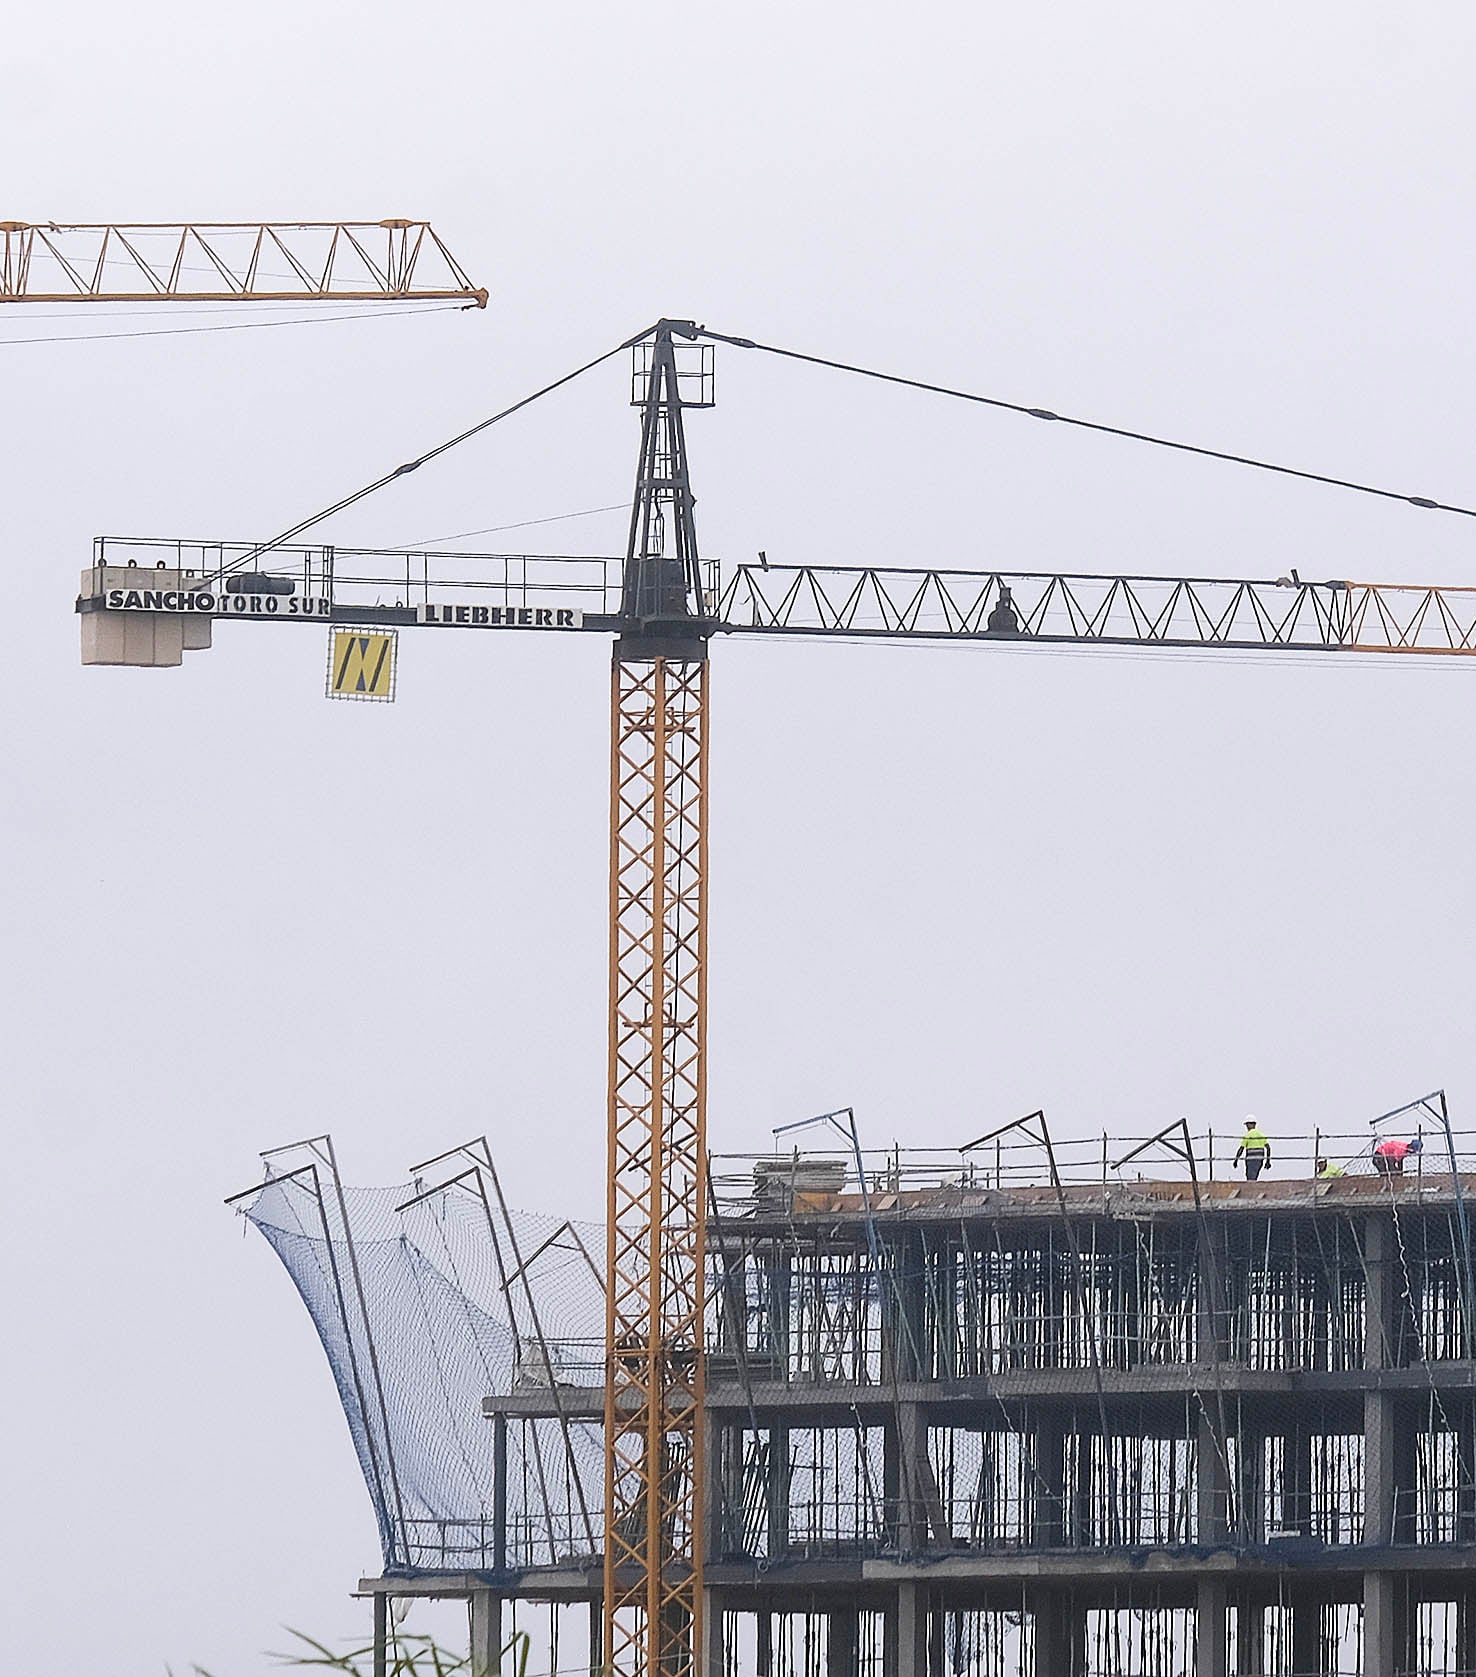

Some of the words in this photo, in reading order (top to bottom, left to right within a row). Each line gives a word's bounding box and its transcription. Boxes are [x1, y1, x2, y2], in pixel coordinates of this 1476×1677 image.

[109, 590, 215, 611] SANCHO
[219, 594, 278, 613] TORO
[288, 597, 330, 615] SUR
[425, 604, 574, 627] LIEBHERR
